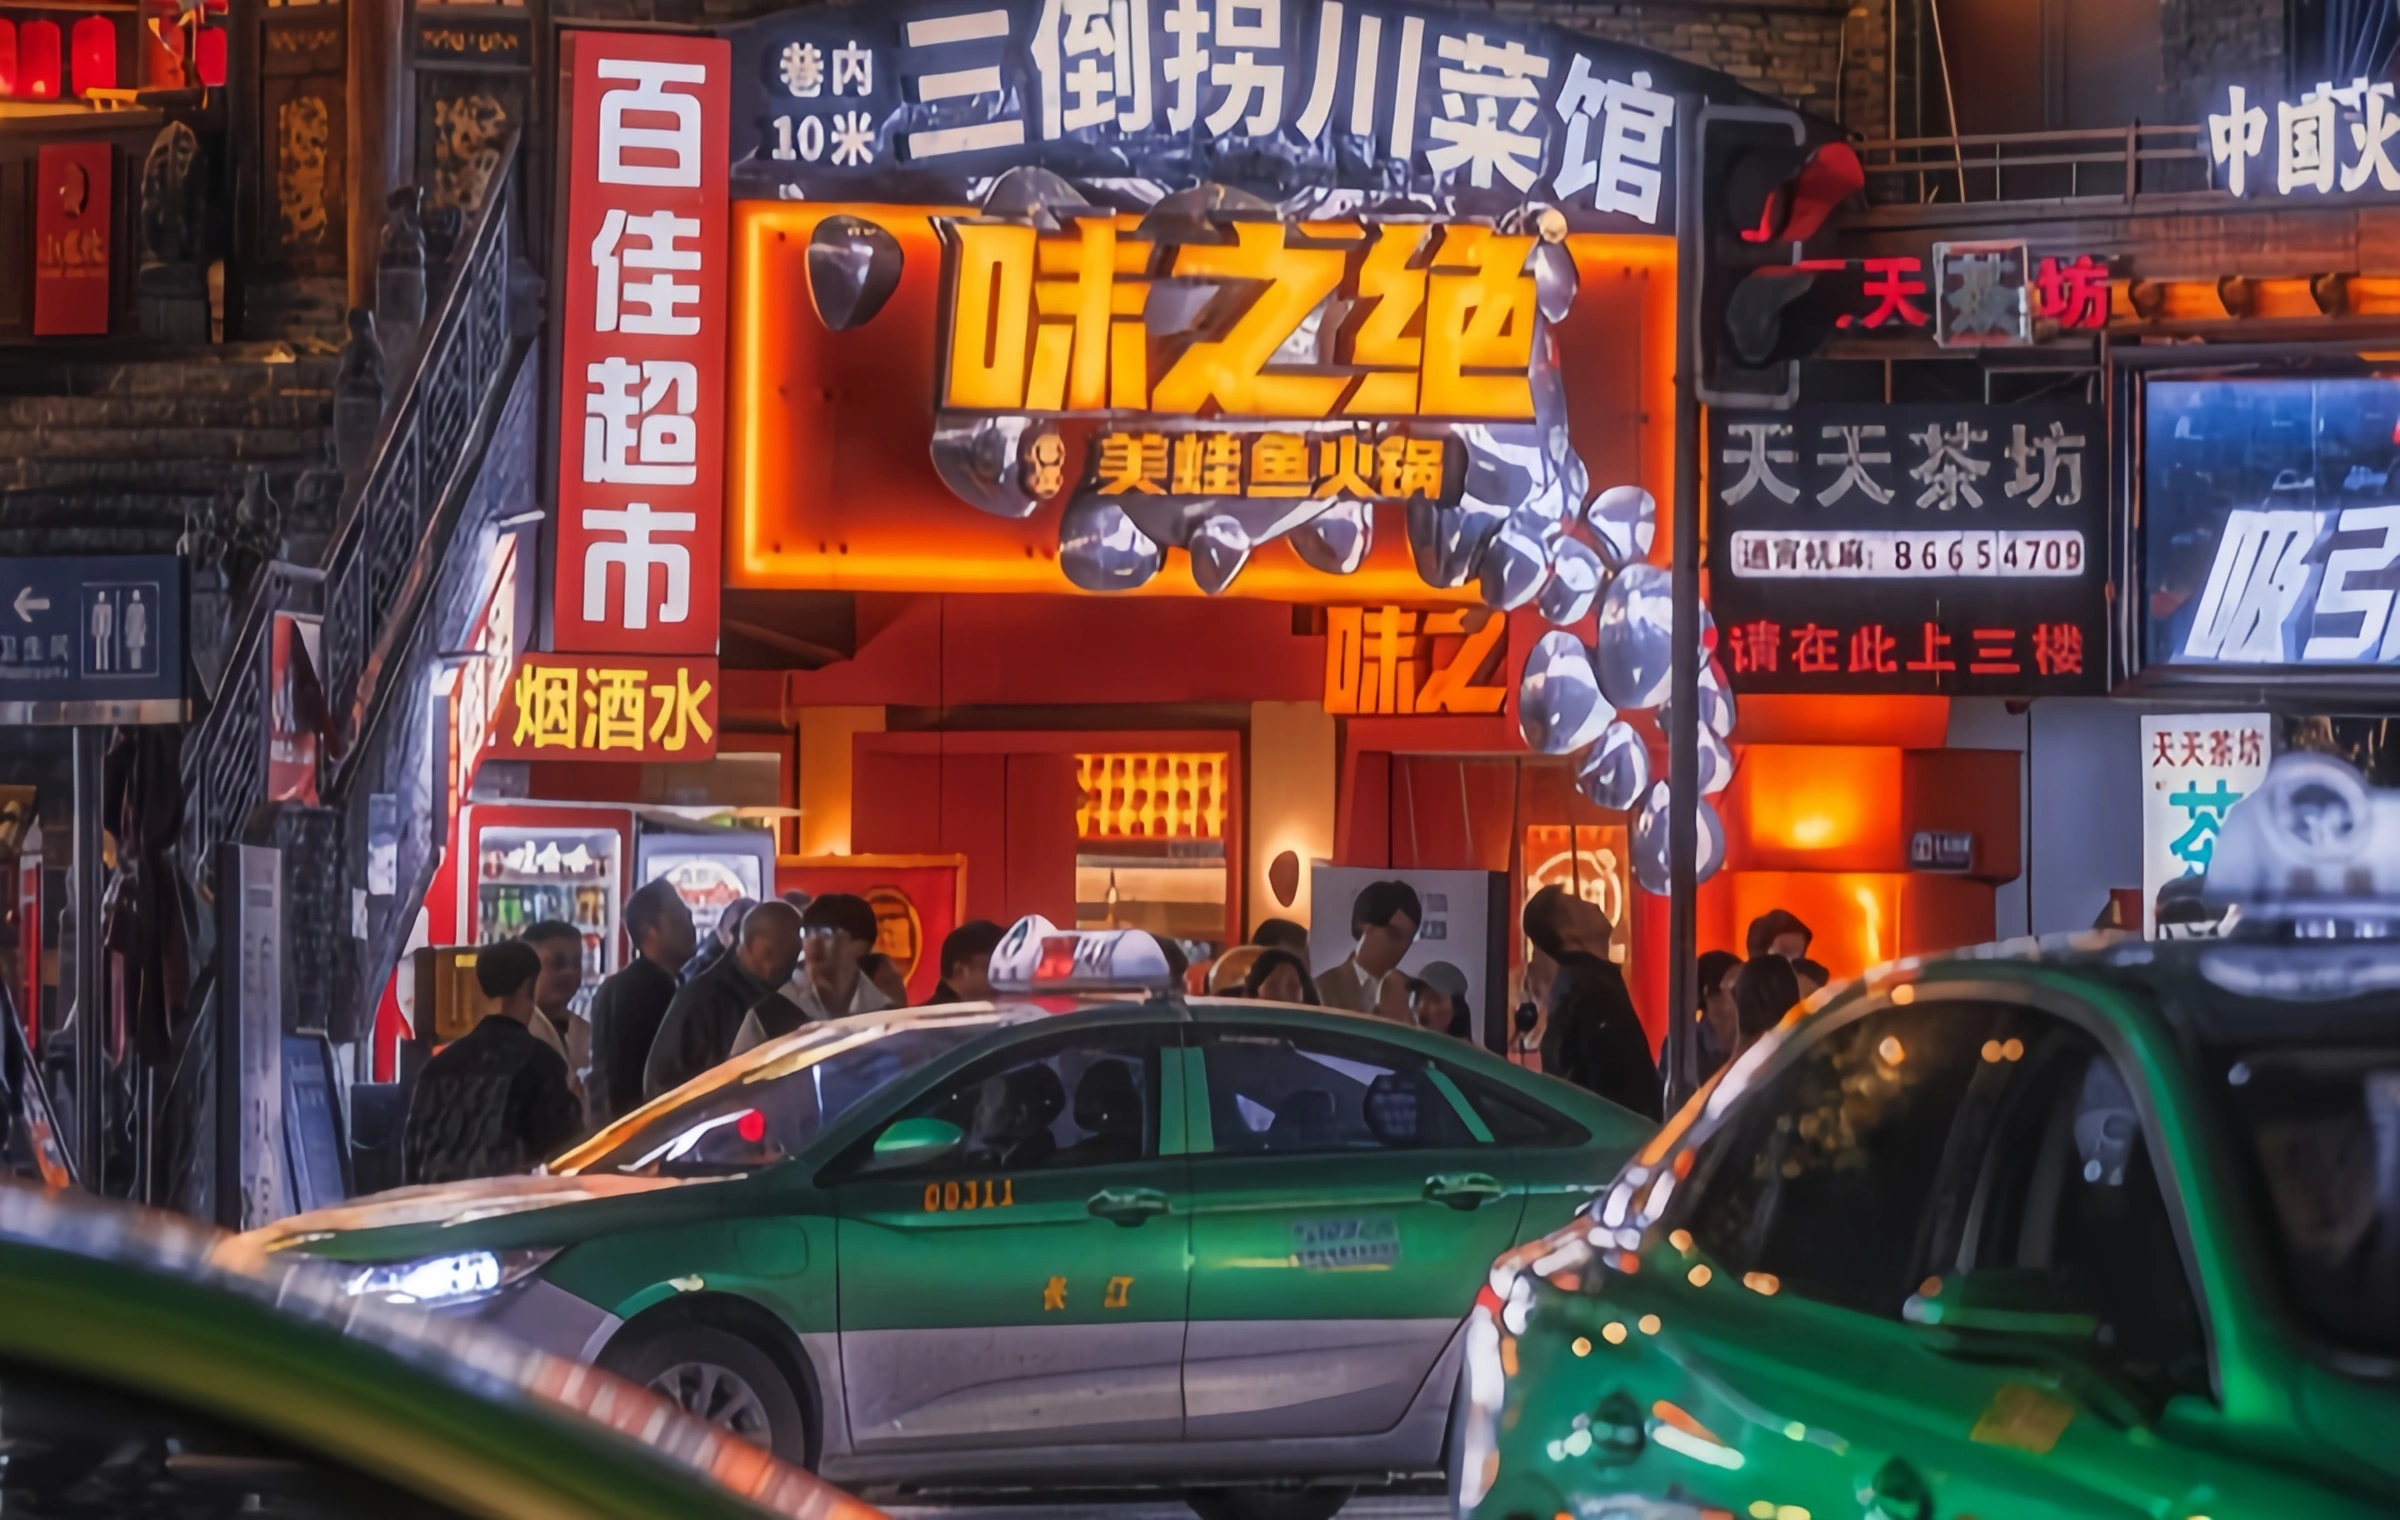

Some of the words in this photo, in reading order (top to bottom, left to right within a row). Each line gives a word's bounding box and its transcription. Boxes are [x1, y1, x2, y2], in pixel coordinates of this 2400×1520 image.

[779, 40, 873, 98] 巷内
[771, 110, 875, 167] 10米
[904, 0, 1676, 225] 三倒拐川菜馆
[581, 58, 707, 630] 百佳超市
[940, 216, 1538, 417] 味之绝
[1097, 430, 1444, 500] 美蛙鱼火锅
[1721, 420, 2086, 509] 天天茶坊
[1894, 539, 2082, 571] 86654709
[1729, 620, 2084, 675] 请在此上三楼
[513, 662, 713, 752] 烟酒水
[2152, 728, 2264, 768] 天天茶坊
